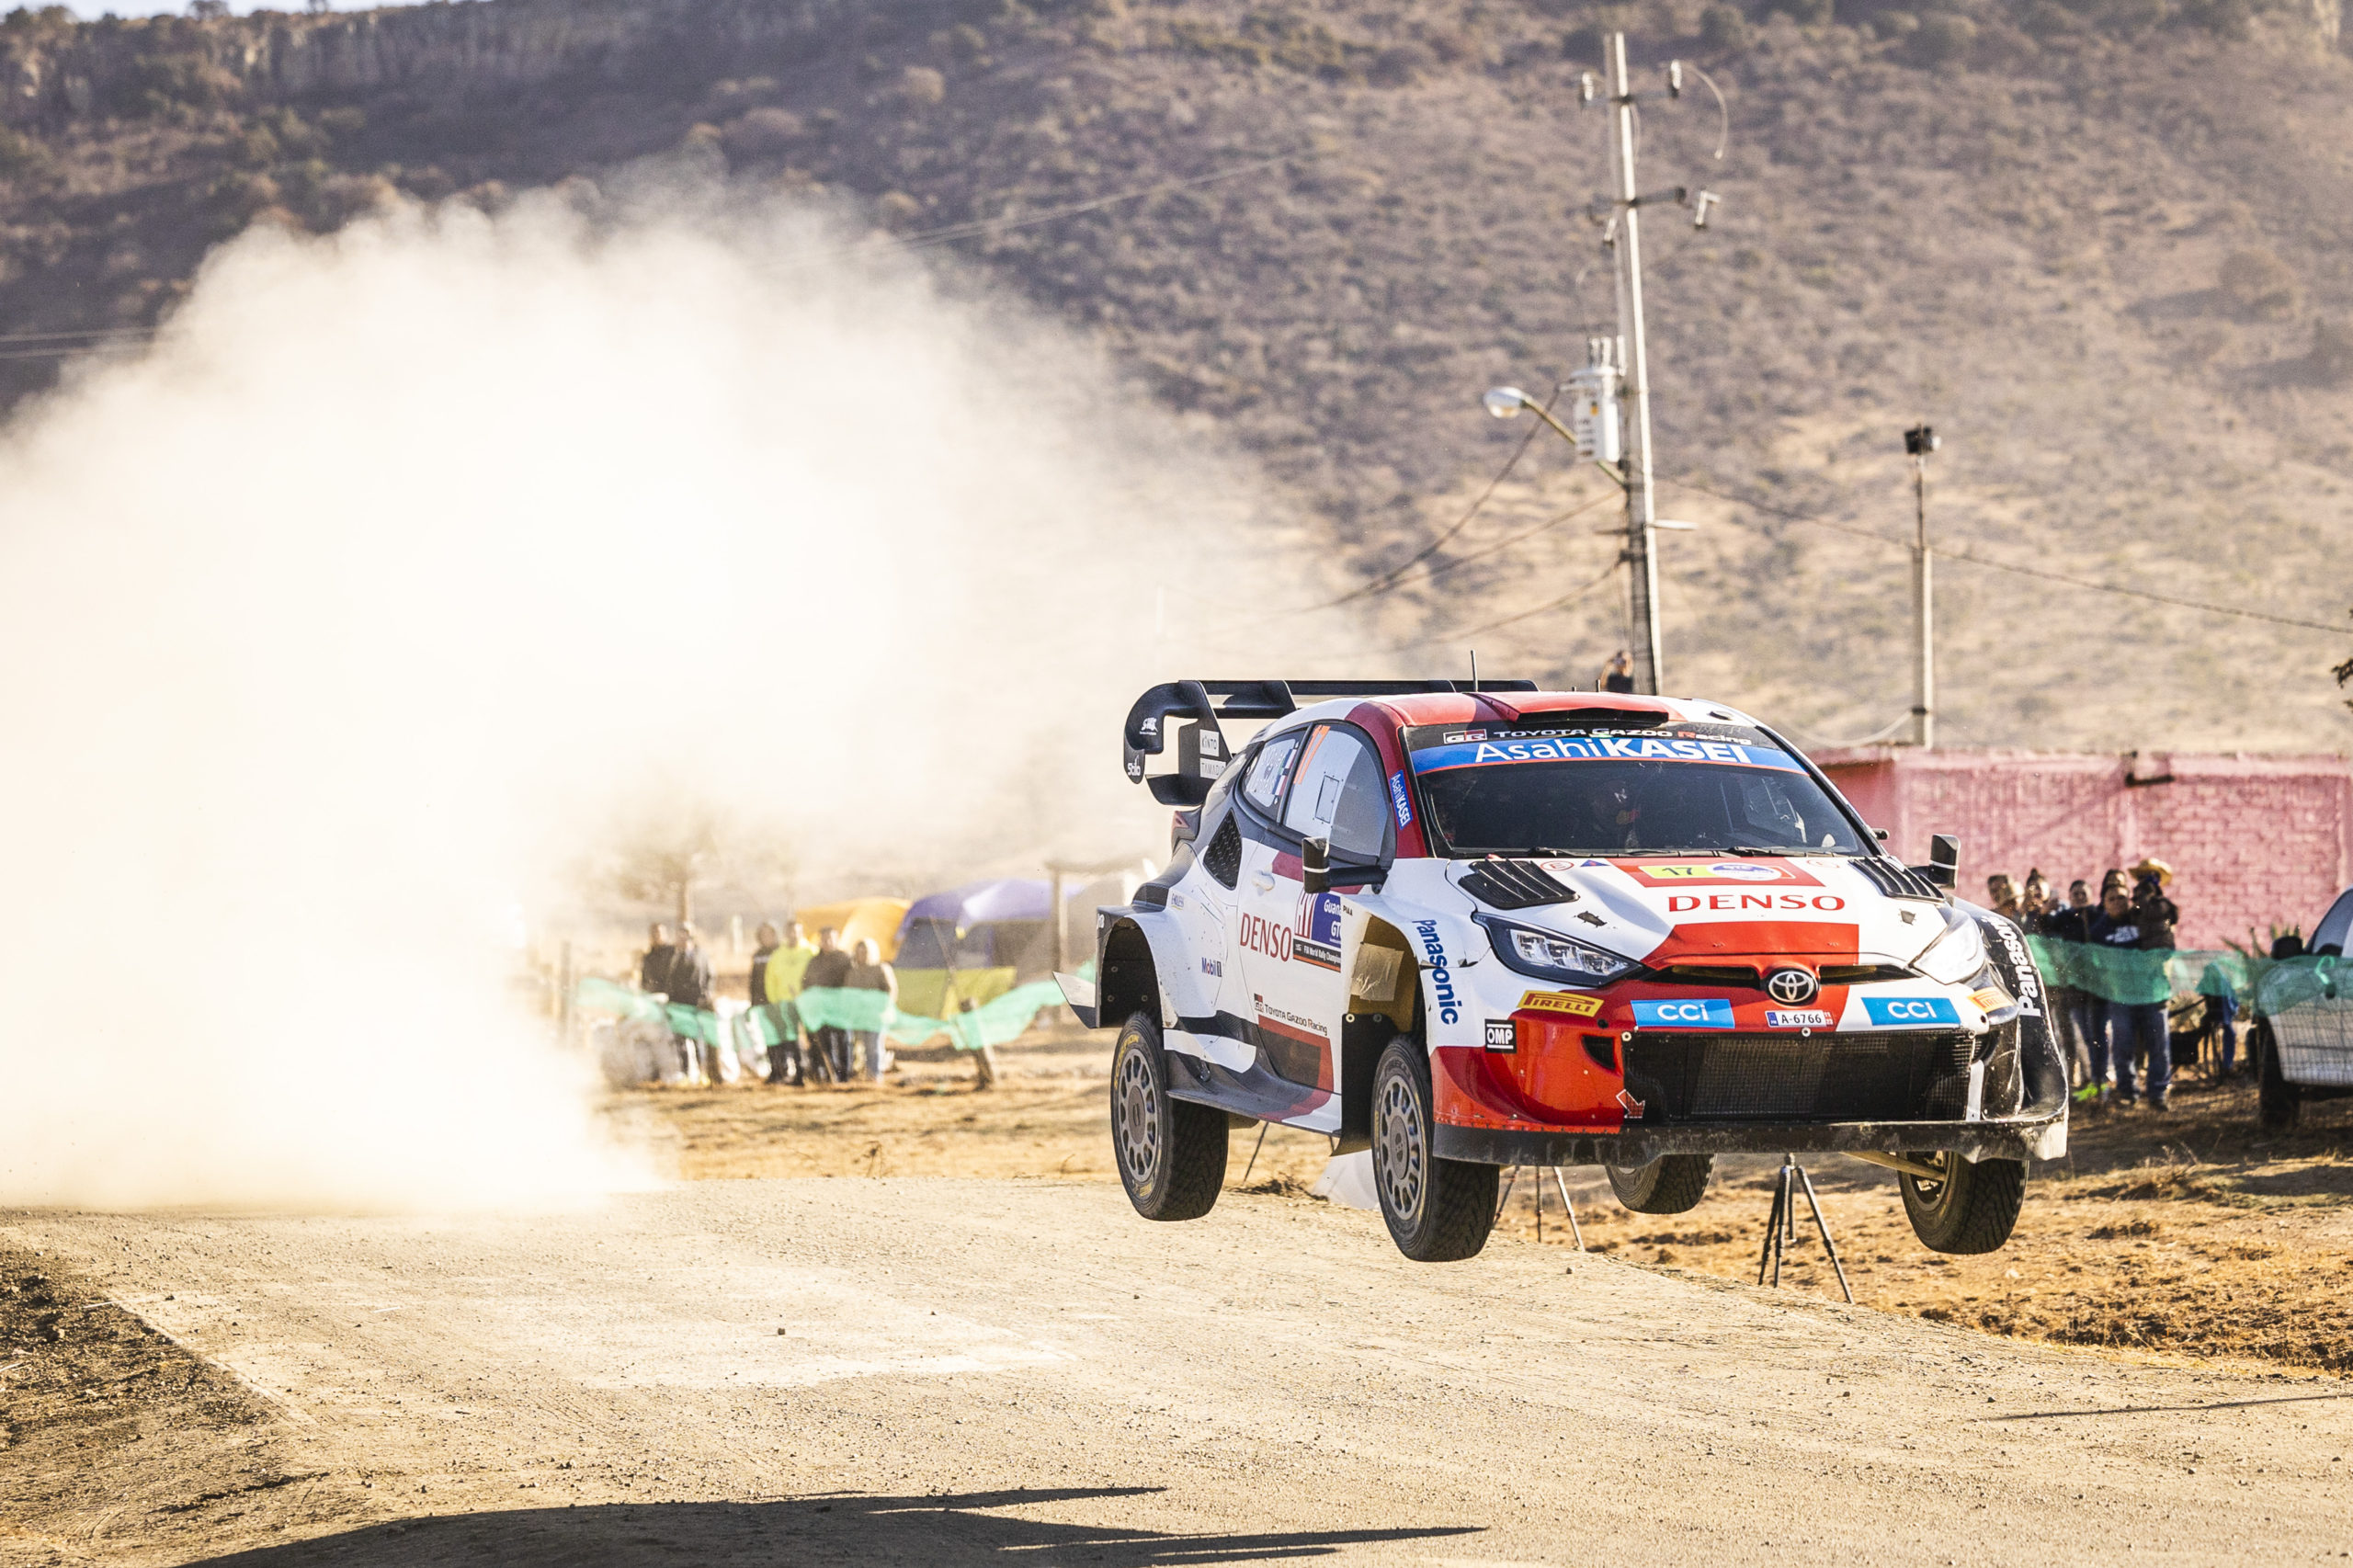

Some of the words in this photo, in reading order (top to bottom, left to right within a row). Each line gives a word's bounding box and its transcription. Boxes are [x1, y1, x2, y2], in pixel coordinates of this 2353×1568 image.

[1494, 729, 1586, 738] TOYOTA
[1677, 731, 1752, 745] Racing
[1662, 867, 1693, 876] 17
[1668, 894, 1845, 912] DENSO
[1239, 912, 1292, 962] DENSO
[1201, 957, 1216, 976] Mobil
[1411, 919, 1462, 1025] Panasonic
[1523, 993, 1596, 1012] PIRELLI
[1265, 1004, 1287, 1020] TOYOTA
[1287, 1012, 1307, 1027] GAZOO
[1308, 1018, 1328, 1037] Racing
[1780, 1013, 1823, 1025] A-6766
[1486, 1028, 1513, 1045] OMP
